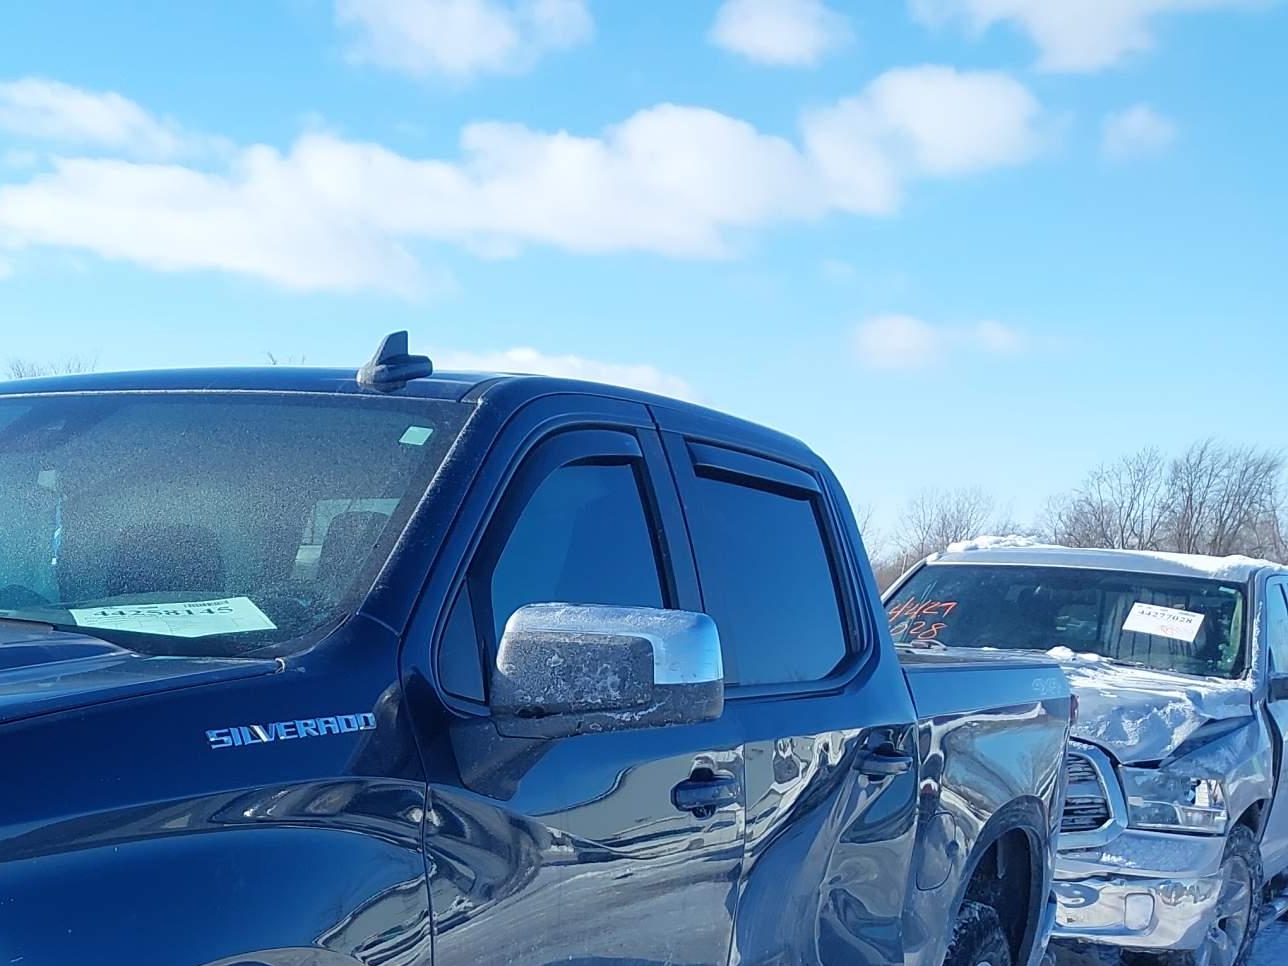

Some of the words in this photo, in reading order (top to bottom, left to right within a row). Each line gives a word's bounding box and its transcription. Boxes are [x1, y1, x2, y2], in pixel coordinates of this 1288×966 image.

[94, 606, 233, 617] 44258145
[888, 596, 957, 622] 4427
[205, 712, 377, 749] SILVERADO
